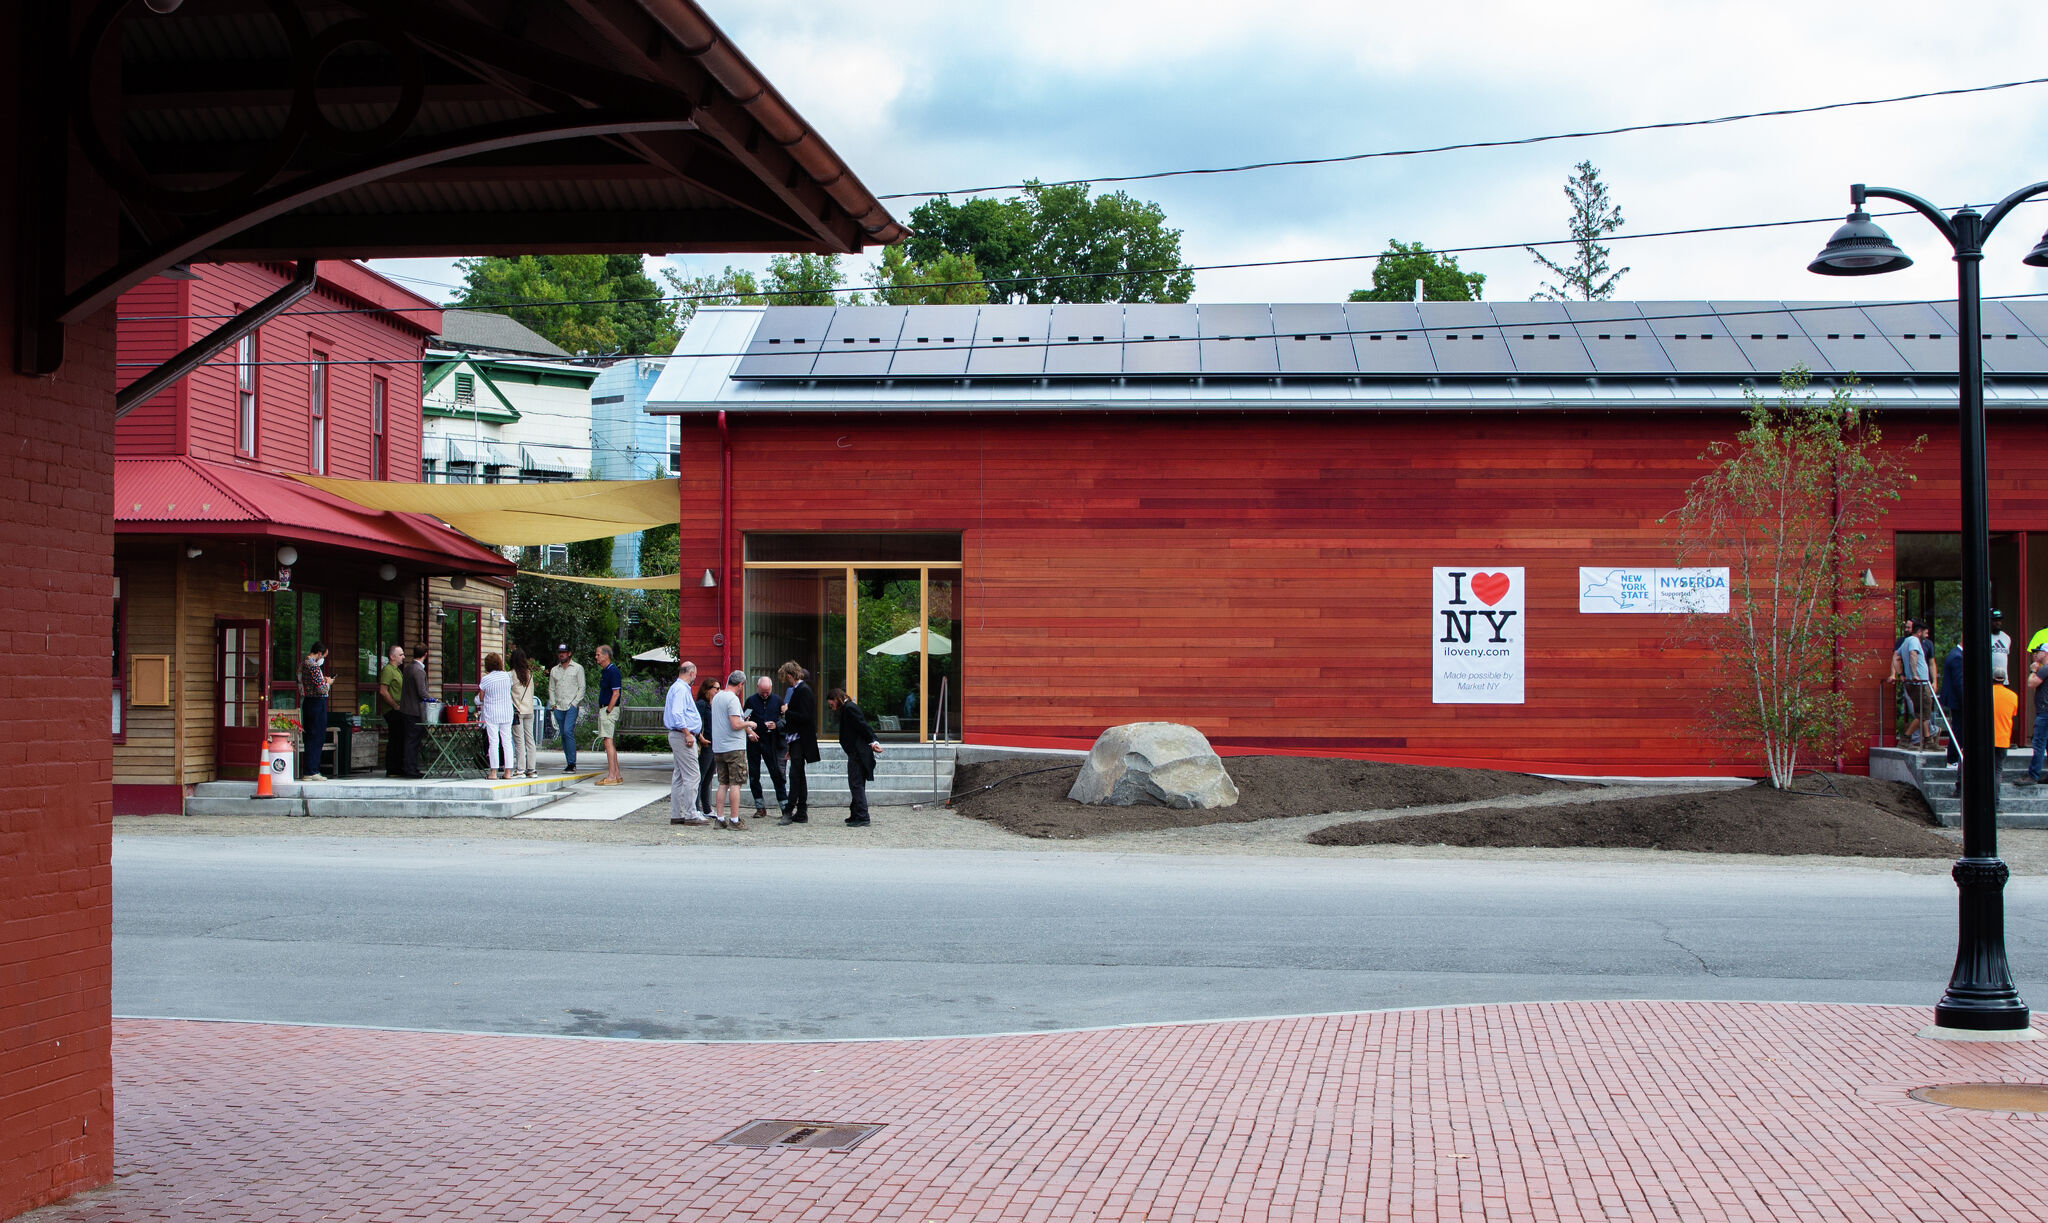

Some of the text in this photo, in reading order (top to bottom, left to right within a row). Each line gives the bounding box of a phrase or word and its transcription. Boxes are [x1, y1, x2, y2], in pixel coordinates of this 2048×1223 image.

[1621, 583, 1647, 591] YORK
[1660, 576, 1726, 588] NYSERDA
[1448, 572, 1467, 605] I
[1621, 591, 1649, 599] STATE
[1440, 610, 1517, 643] NY
[1444, 647, 1510, 658] iloveny.com
[1443, 671, 1513, 681] Made possible by
[1457, 682, 1500, 690] Market NY
